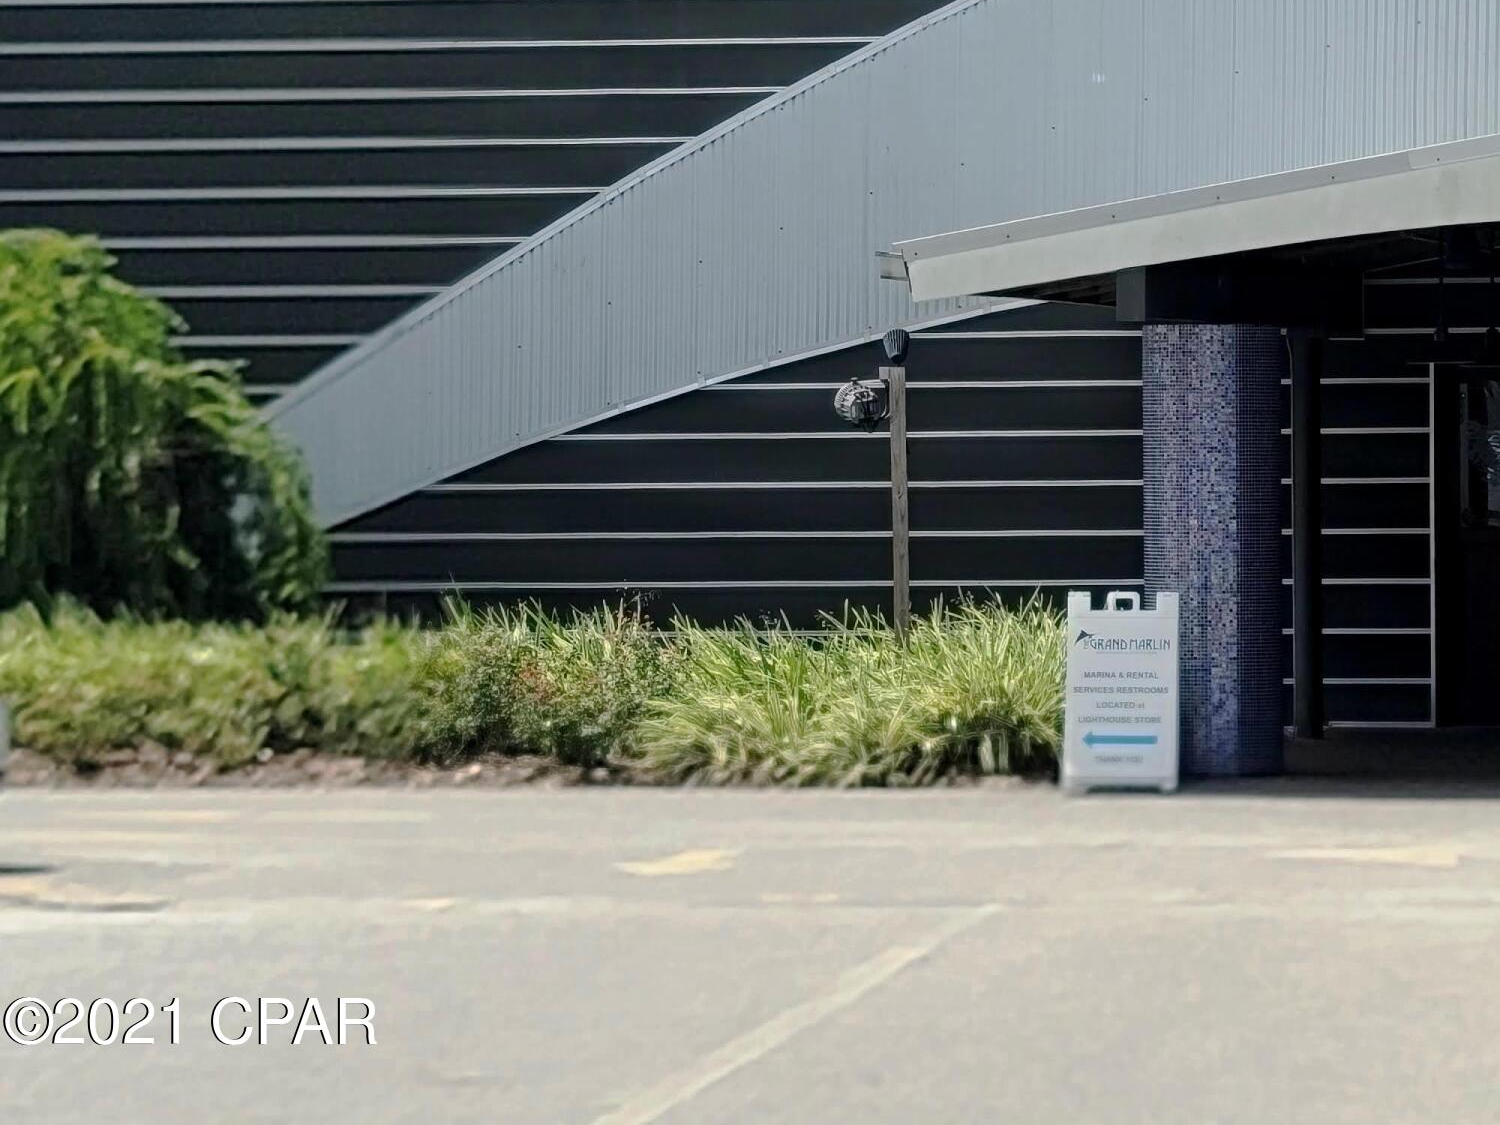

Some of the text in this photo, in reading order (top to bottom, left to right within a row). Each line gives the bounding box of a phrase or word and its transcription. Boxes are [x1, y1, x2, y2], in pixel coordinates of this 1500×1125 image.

[1089, 638, 1128, 650] GRAND
[1129, 638, 1171, 651] MARLIN
[1083, 671, 1117, 680] MARINA
[1126, 671, 1159, 680] RENTAL
[1073, 686, 1169, 694] SERVICES RESTROOMS
[1096, 701, 1136, 709] LOCATED
[1078, 716, 1162, 724] LIGHTHOUSE STORE
